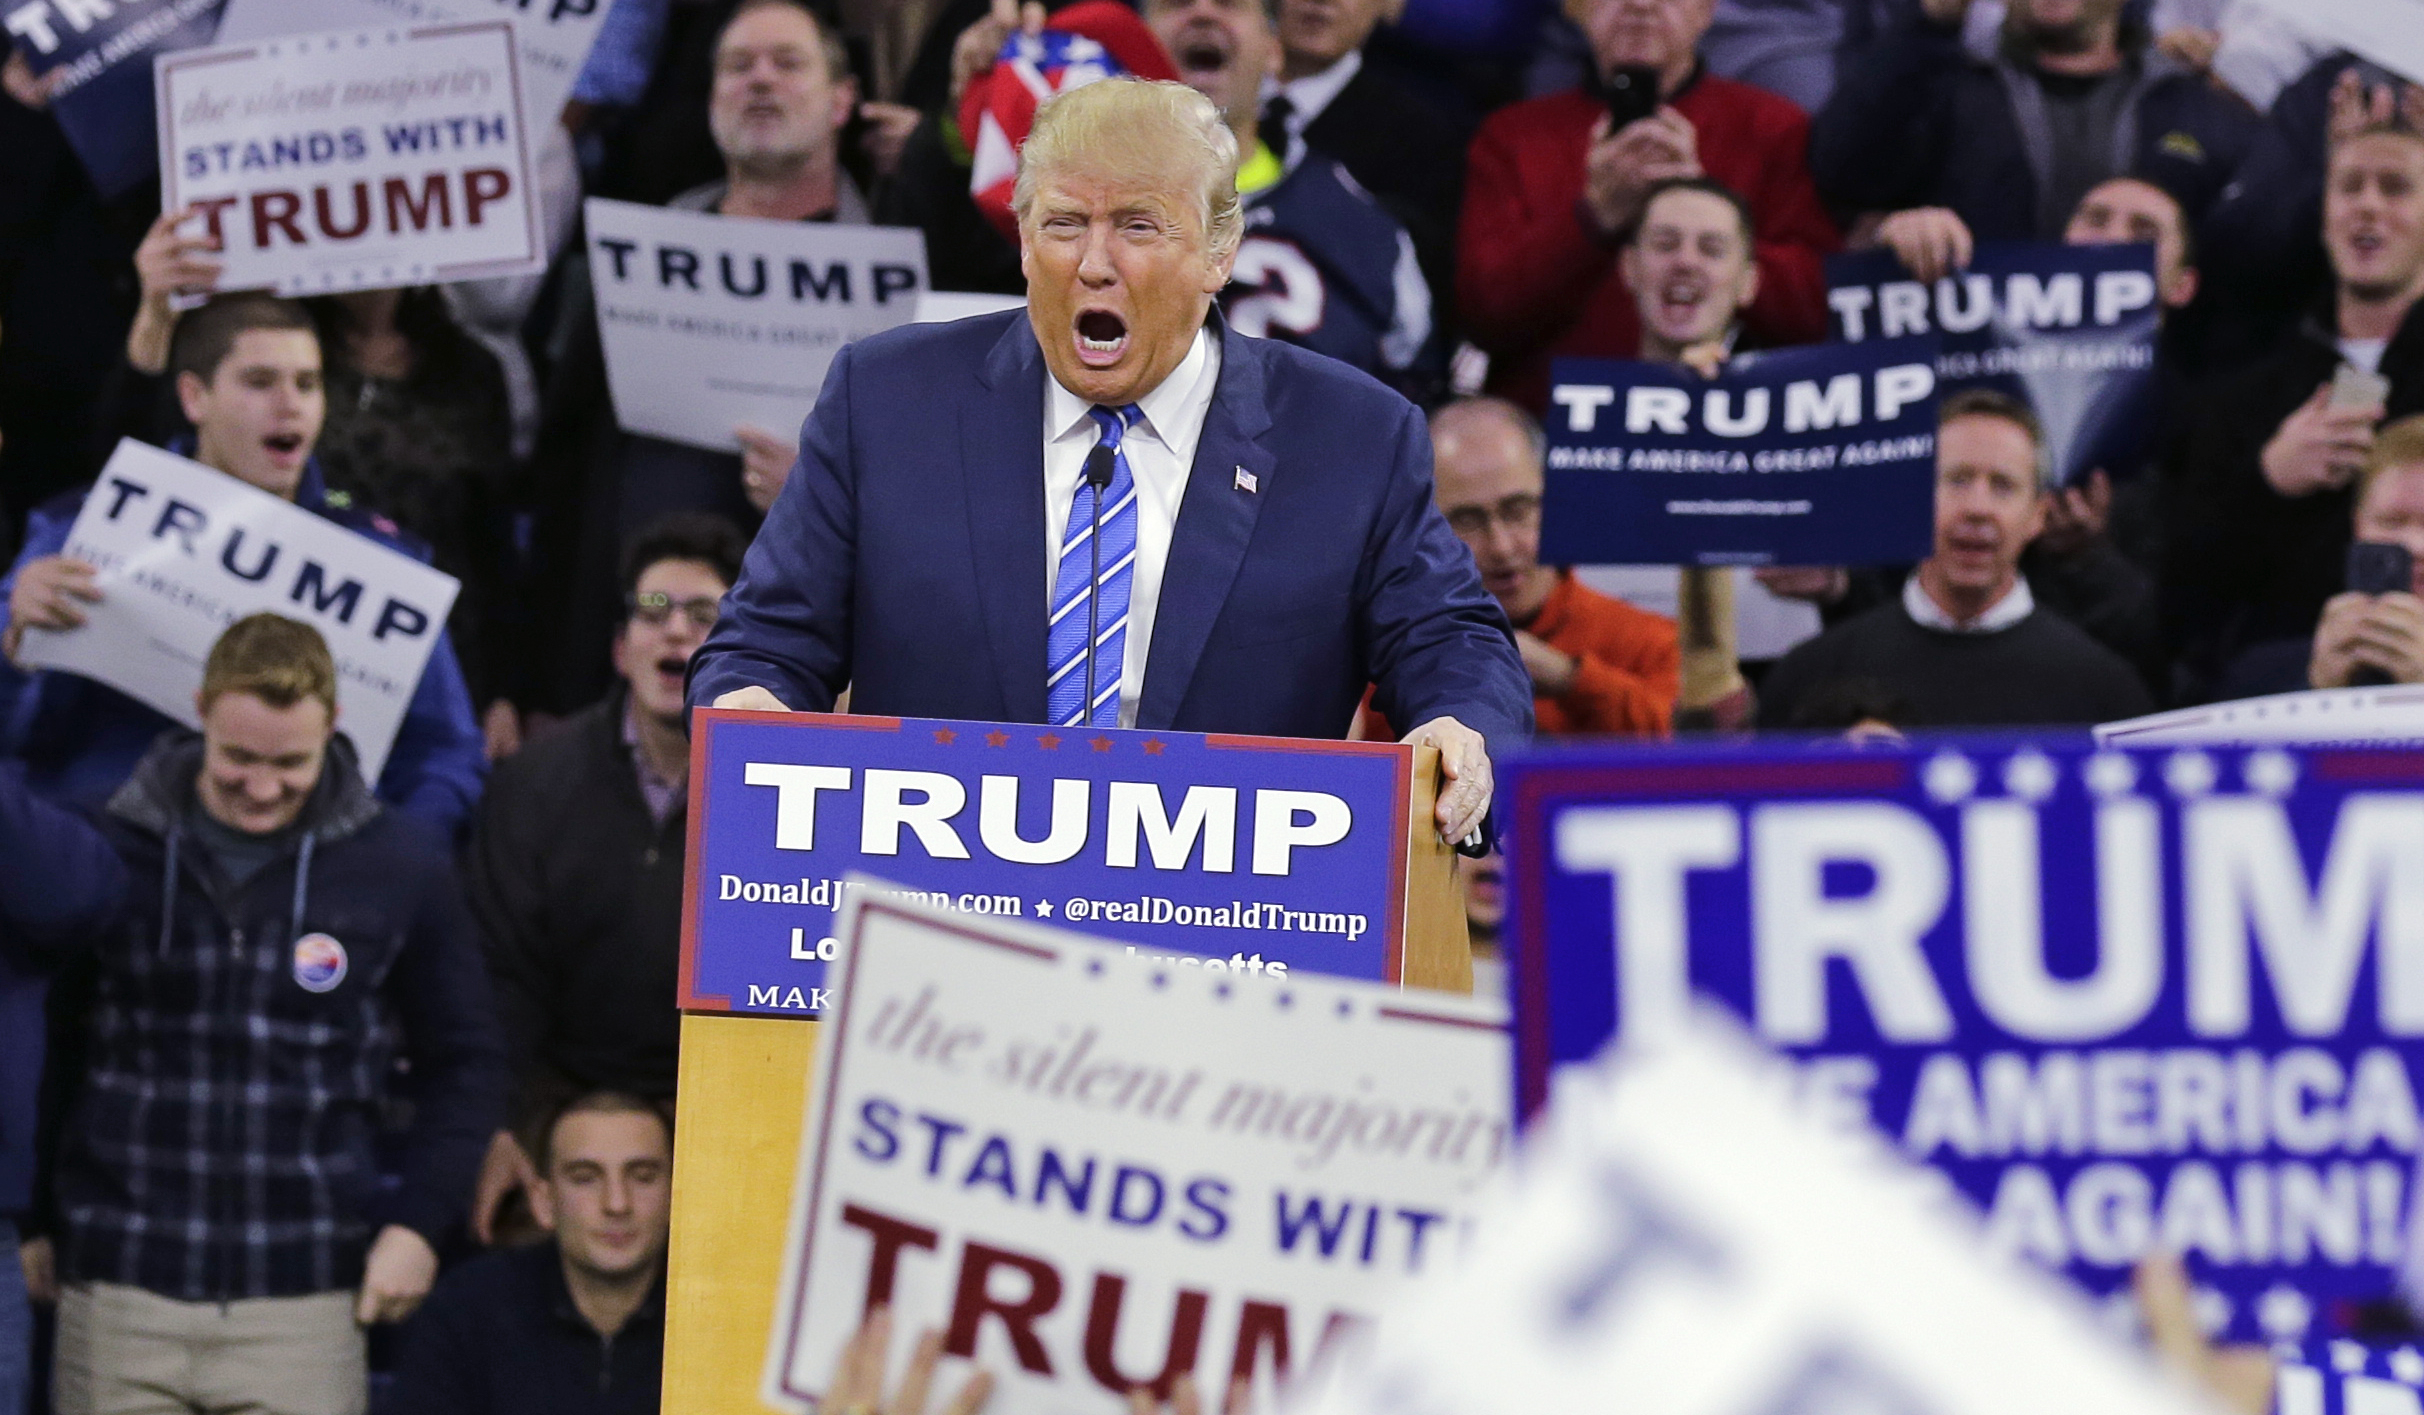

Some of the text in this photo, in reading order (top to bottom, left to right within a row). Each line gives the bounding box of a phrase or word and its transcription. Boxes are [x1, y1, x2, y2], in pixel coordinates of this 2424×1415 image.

[184, 113, 508, 179] STANDS WITH
[188, 168, 511, 252] TRUMP
[598, 239, 918, 305] TRUMP
[1827, 270, 2156, 343] TRUMP
[1552, 362, 1936, 438] TRUMP
[1547, 432, 1935, 475] MAKE AMERICA GREAT AGAIN!
[110, 477, 430, 642] TRUMP
[743, 761, 1354, 877] TRUMP
[718, 873, 1369, 941] DonaldJmp.com @realDonaldTrump
[1552, 793, 2424, 1050] TRUM
[746, 983, 835, 1011] MAK
[864, 983, 970, 1076] the
[990, 1022, 1203, 1130] silent
[1207, 1072, 1508, 1195] majority
[1903, 1045, 2424, 1163] AMERICA
[851, 1096, 1234, 1246] STANDS
[1272, 1188, 1480, 1280] WIT
[1996, 1155, 2404, 1270] AGAIN!
[841, 1202, 1385, 1408] TRUM
